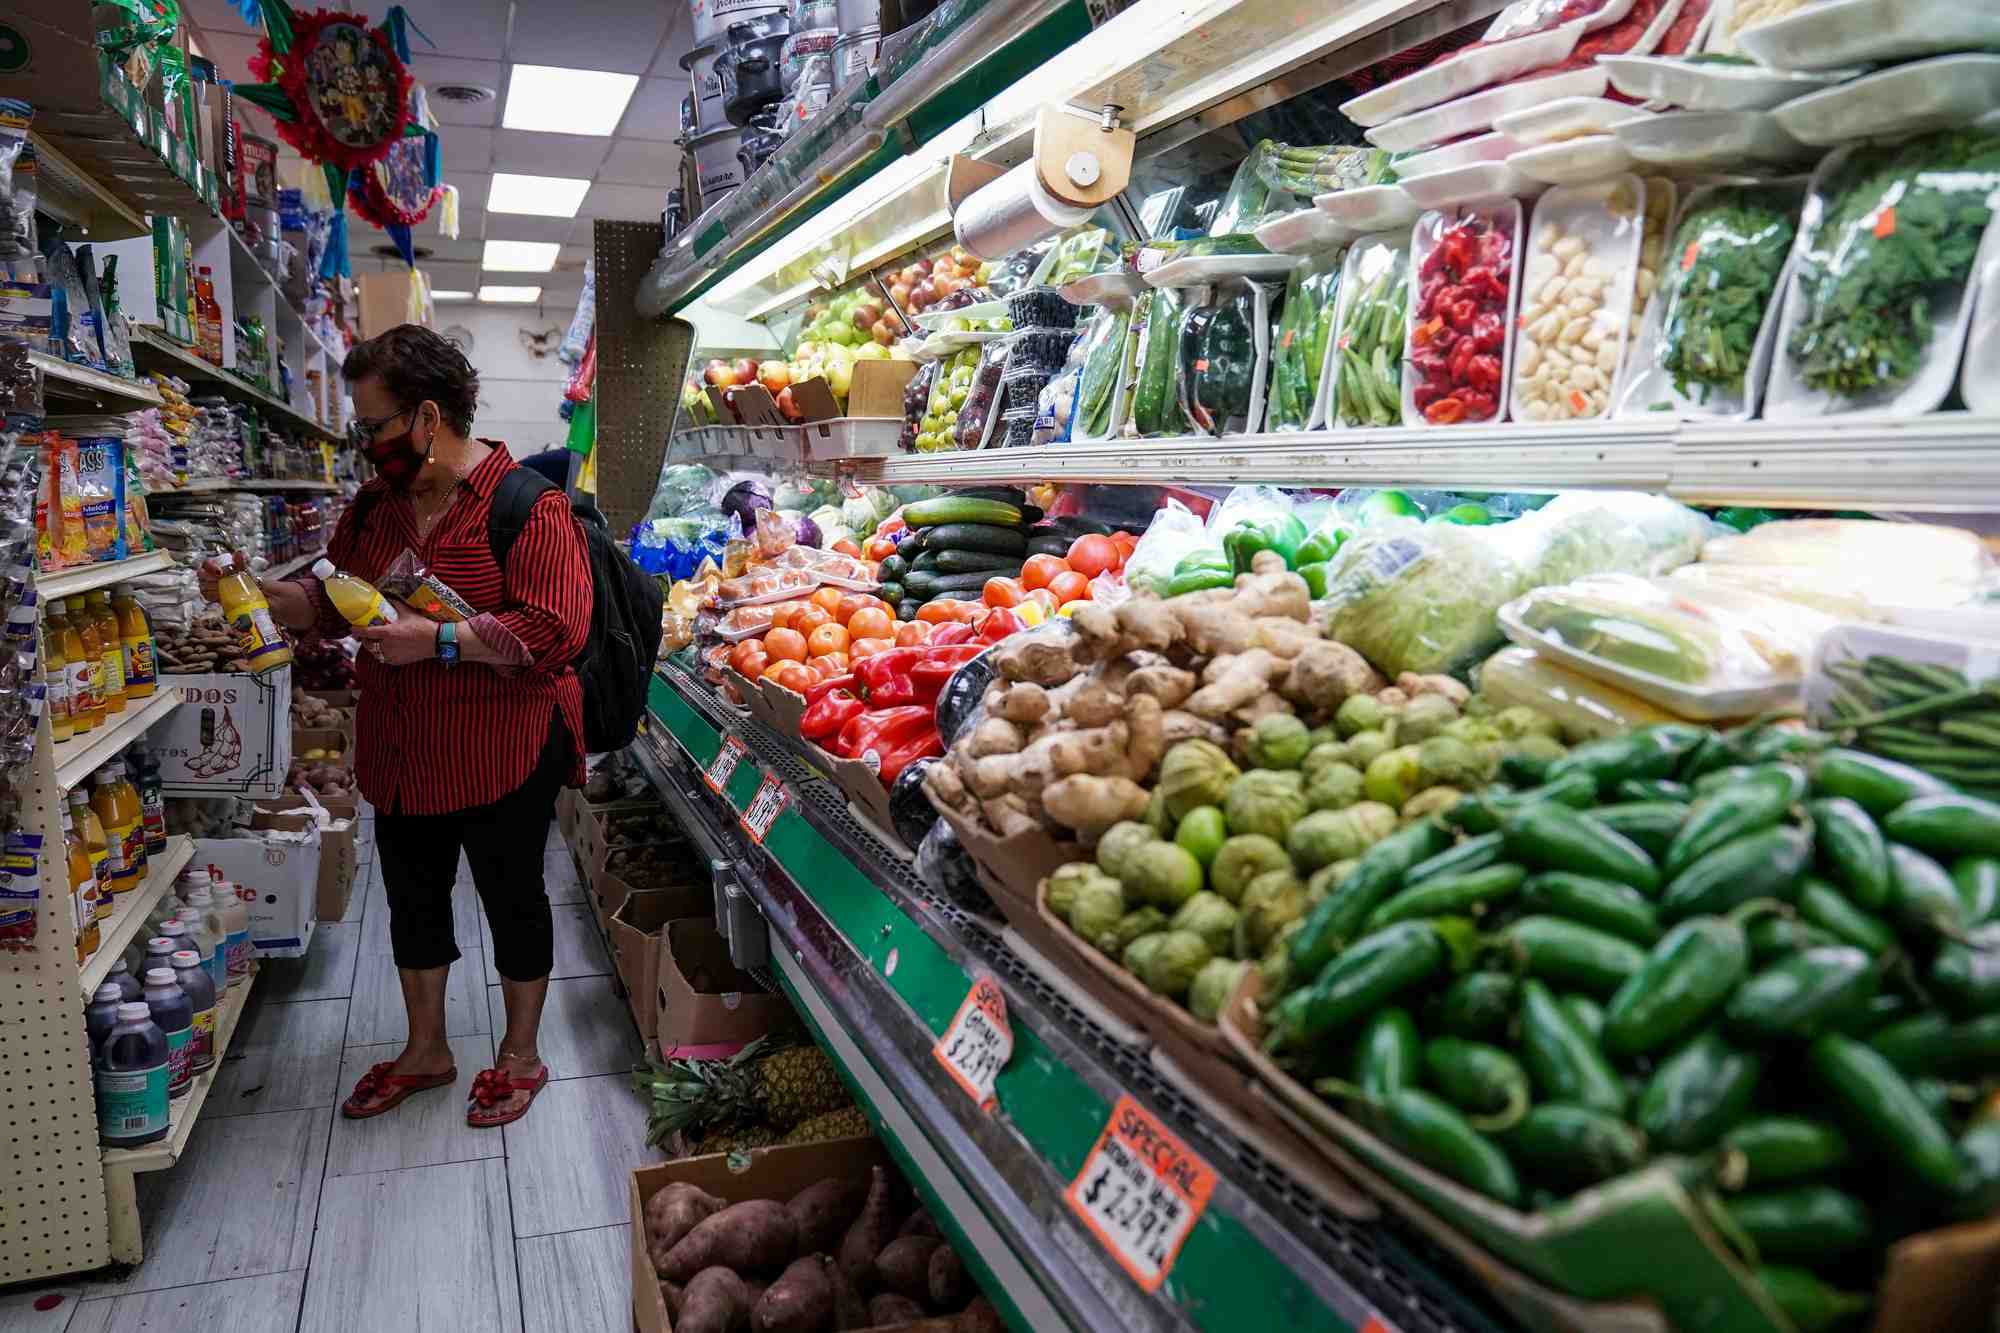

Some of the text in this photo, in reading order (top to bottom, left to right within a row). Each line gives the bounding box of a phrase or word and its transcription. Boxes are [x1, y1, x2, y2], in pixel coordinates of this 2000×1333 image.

[79, 450, 104, 472] ASS
[181, 687, 237, 704] DOS
[1118, 1108, 1198, 1199] SPECIAL
